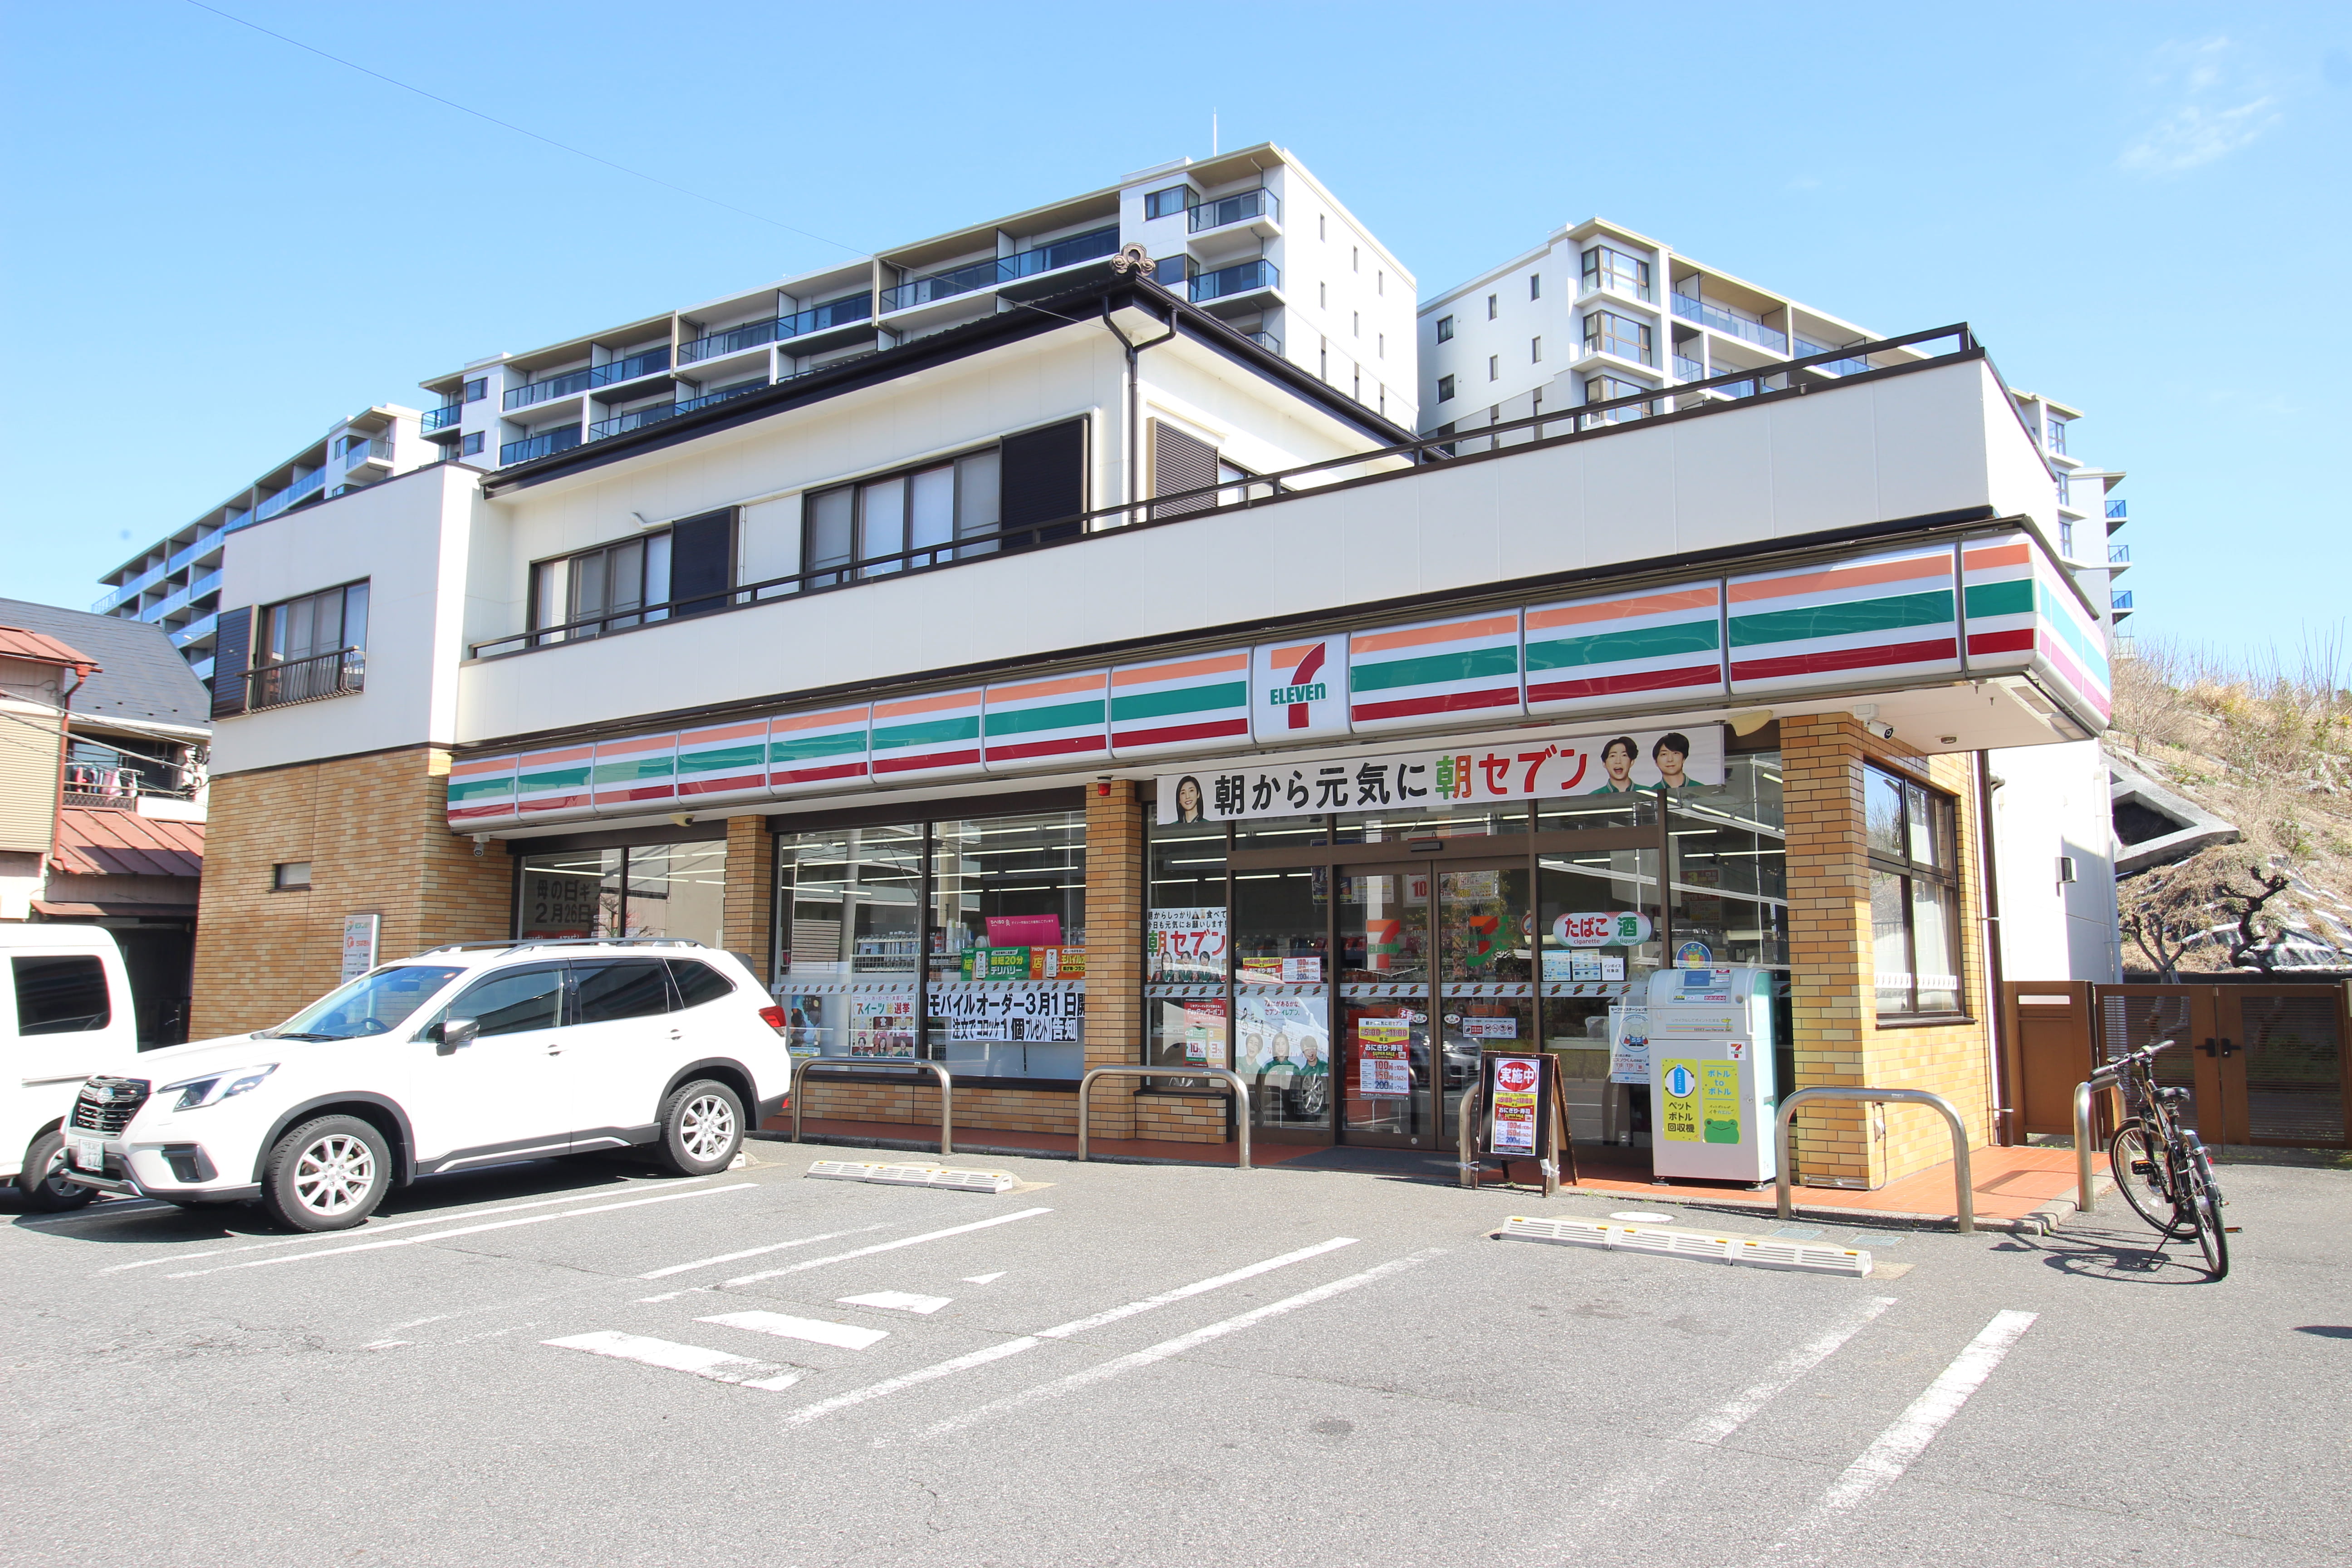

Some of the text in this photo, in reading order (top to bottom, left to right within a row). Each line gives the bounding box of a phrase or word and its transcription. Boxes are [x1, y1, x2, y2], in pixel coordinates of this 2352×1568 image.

[1270, 642, 1325, 730] 7
[1214, 744, 1588, 816] 朝から元気に朝セブン
[1565, 916, 1637, 938] たばこ 酒
[1148, 929, 1225, 957] 朝セブン
[991, 956, 1024, 965] 最短20分
[991, 966, 1022, 975] デリバリー
[857, 1002, 910, 1015] スイーツ総選挙
[1400, 1009, 1413, 1022] 予告
[1365, 1044, 1403, 1052] おにぎり・寿司
[1500, 1067, 1534, 1084] 実施中
[1707, 1069, 1730, 1078] ボトル
[1669, 1102, 1691, 1110] ペット
[1669, 1112, 1693, 1122] ボトル
[1667, 1123, 1695, 1133] 回収機
